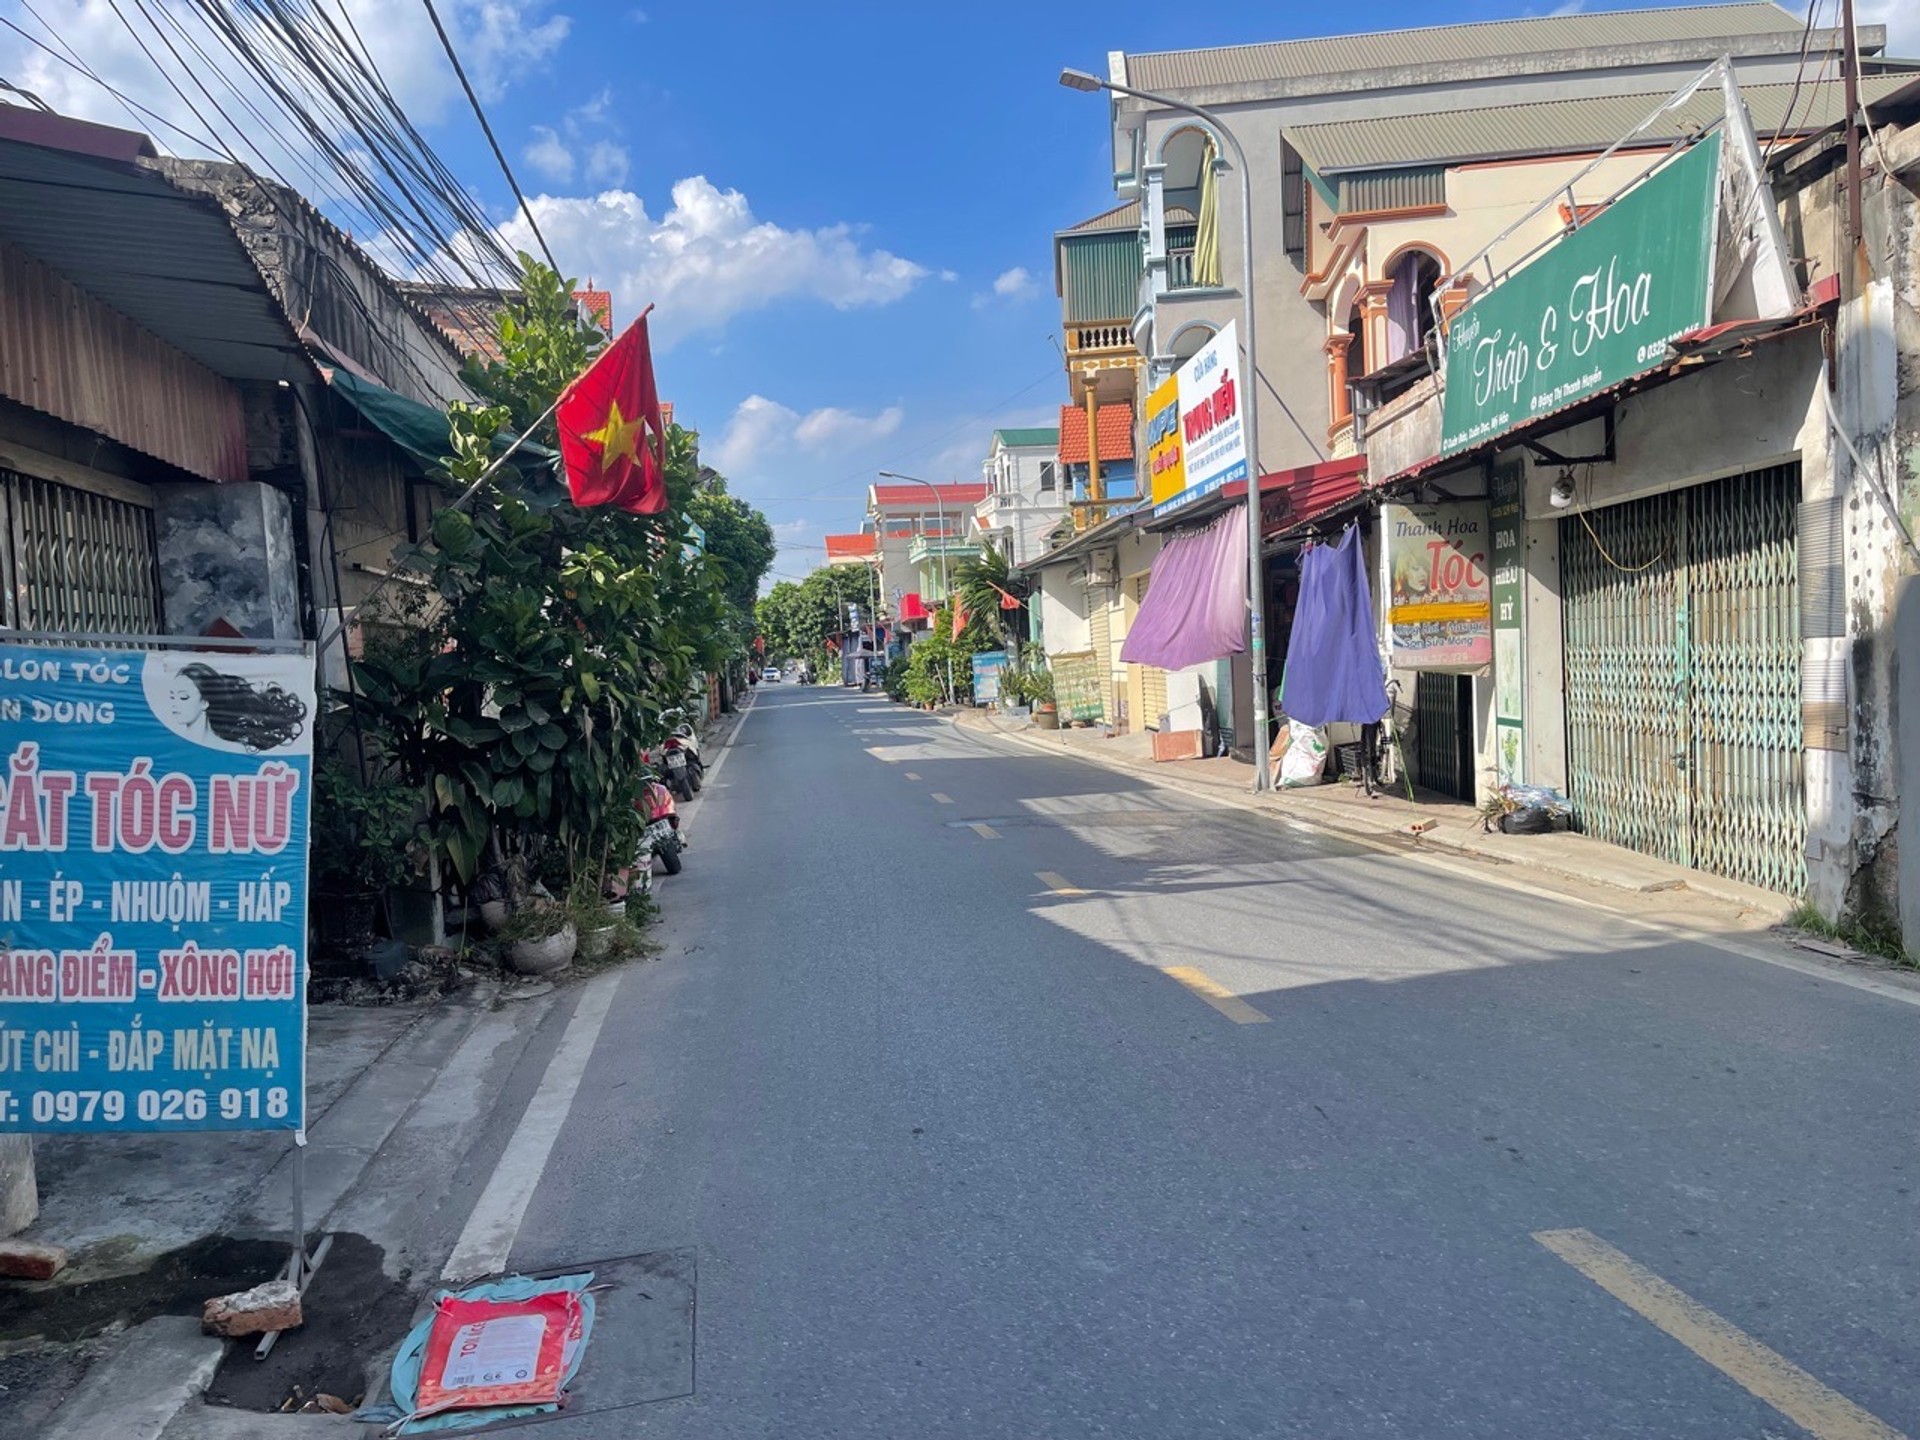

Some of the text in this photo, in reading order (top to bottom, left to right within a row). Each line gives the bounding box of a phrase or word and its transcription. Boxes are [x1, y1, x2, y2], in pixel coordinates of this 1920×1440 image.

[1473, 254, 1652, 407] Tráp & Hoa
[1396, 516, 1478, 538] Thanh Hoa
[1495, 528, 1516, 549] HOA
[1426, 539, 1485, 591] Tóc
[0, 656, 130, 684] LON TÓC
[31, 699, 115, 724] DUNG
[0, 741, 300, 855] ẮT TÓC NỮ
[49, 870, 84, 922] ÉP
[111, 871, 211, 932] NHUỘM
[238, 867, 291, 922] HẤP
[59, 931, 136, 1002] ĐIỂM
[158, 939, 240, 1002] XÔNG
[244, 944, 296, 1001] HƠI
[34, 1021, 80, 1072] CHÌ
[108, 1013, 163, 1072] ĐẮP
[173, 1019, 233, 1080] MẶT
[241, 1027, 280, 1079] NẠ
[32, 1089, 125, 1122] 0979
[137, 1088, 207, 1121] 026
[220, 1087, 289, 1120] 918
